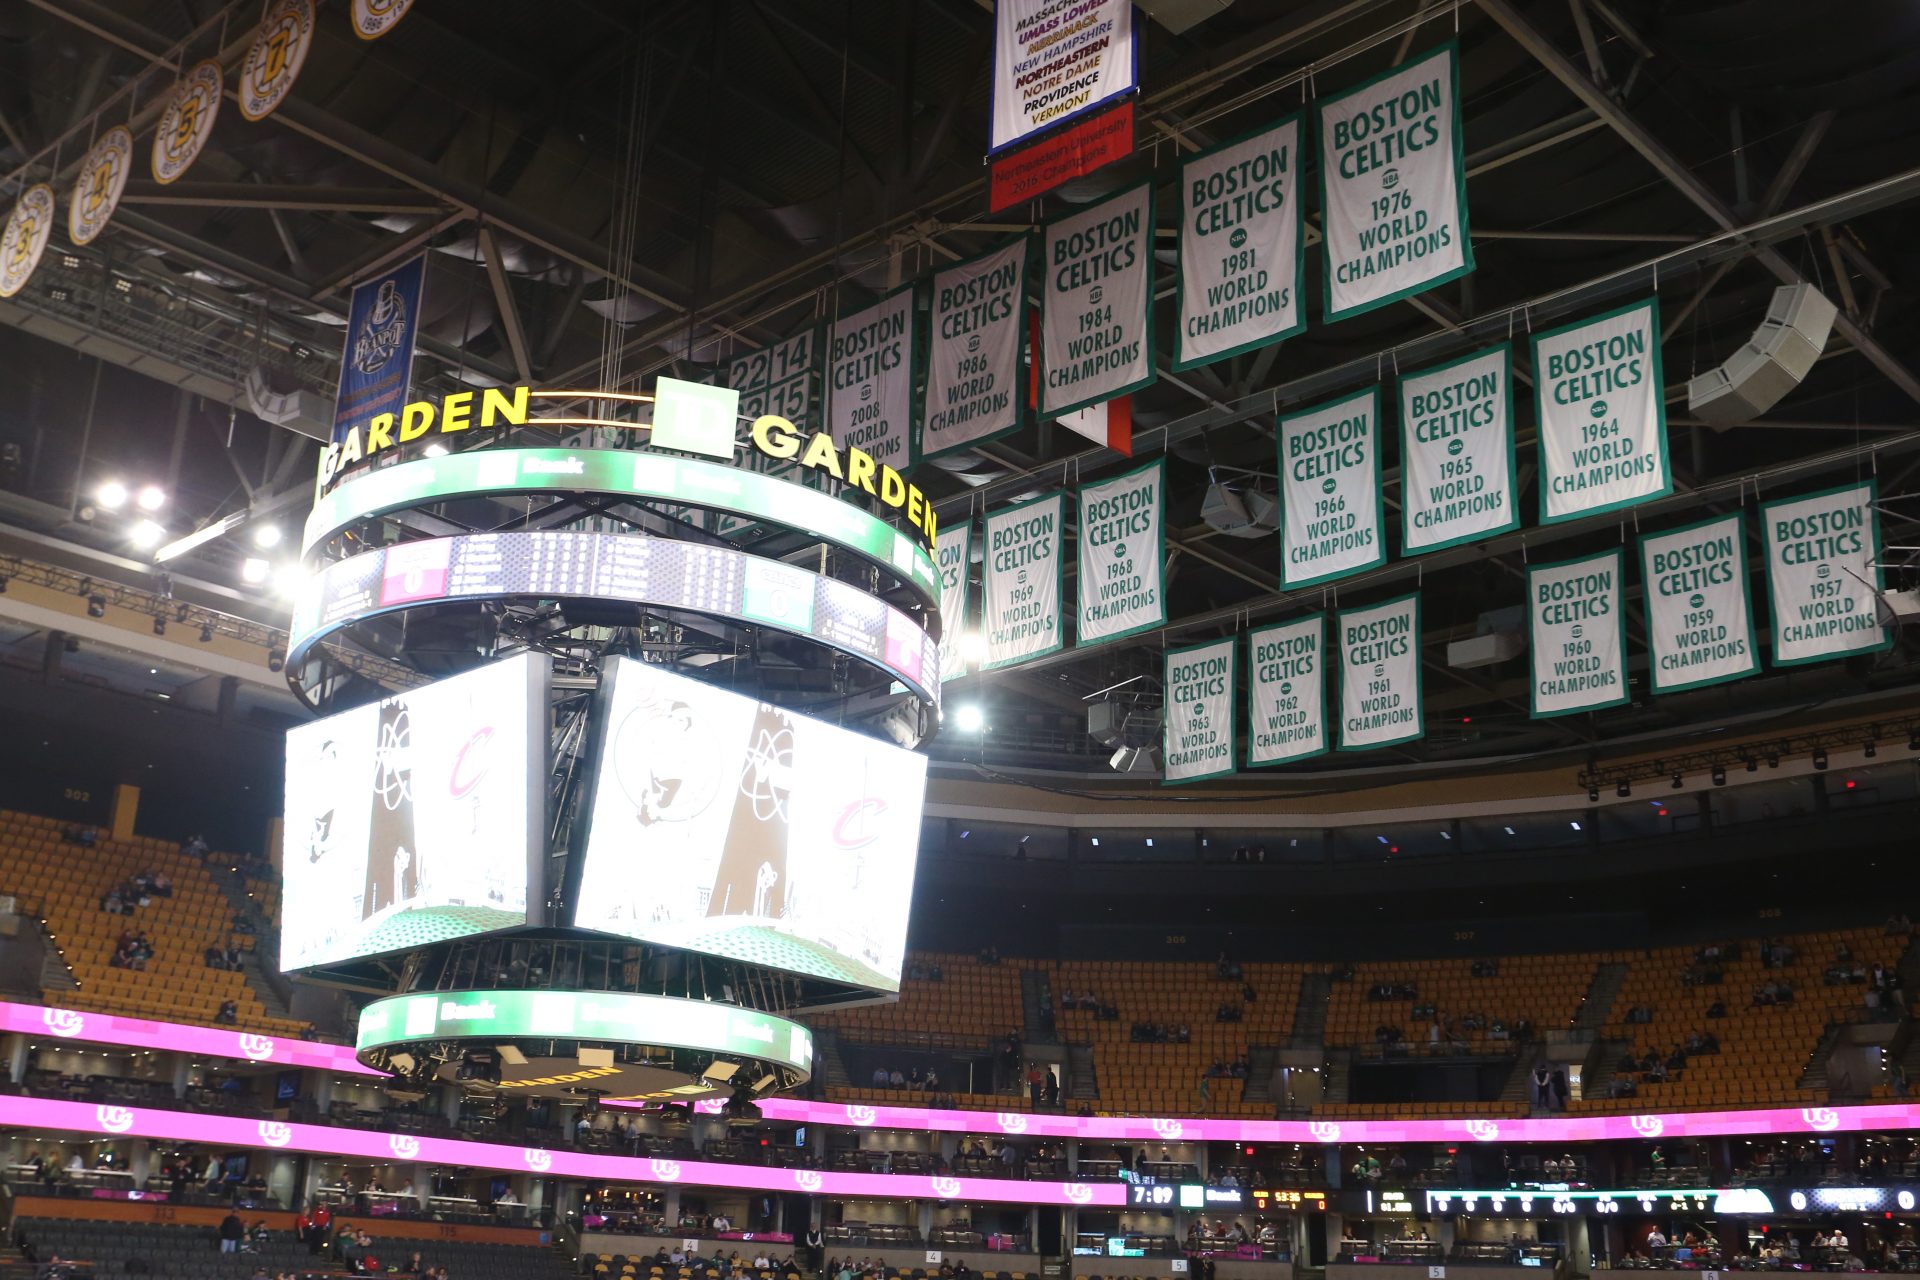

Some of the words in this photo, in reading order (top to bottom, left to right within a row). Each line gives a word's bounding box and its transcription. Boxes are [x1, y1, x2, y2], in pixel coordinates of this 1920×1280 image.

[1019, 17, 1059, 45] UMASS
[1013, 57, 1040, 76] NEW
[1044, 20, 1113, 62] HAMPSHIRE
[1016, 36, 1109, 89] NORTHEASTERN
[1023, 74, 1061, 100] NOTRE
[1066, 55, 1101, 80] DAME
[1024, 72, 1099, 114] PROVIDENCE
[1032, 90, 1091, 125] VERMONT
[1335, 79, 1440, 150] BOSTON
[995, 144, 1069, 183] Northeastern
[1071, 118, 1127, 150] University
[1043, 145, 1107, 180] Champions
[1340, 116, 1439, 179] CELTICS
[1192, 145, 1287, 208] BOSTON
[1196, 180, 1284, 236] CELTICS
[1372, 189, 1411, 221] 1976
[1054, 208, 1139, 265] BOSTON
[1360, 210, 1427, 251] WORLD
[1057, 240, 1135, 292] CELTICS
[1222, 249, 1255, 277] 1981
[1337, 225, 1450, 284] CHAMPIONS
[940, 262, 1016, 313] BOSTON
[1208, 270, 1267, 307] WORLD
[942, 292, 1011, 339] CELTICS
[1079, 305, 1111, 333] 1984
[1189, 288, 1288, 337] CHAMPIONS
[352, 320, 407, 366] BEANPOT
[834, 310, 904, 362] BOSTON
[1068, 326, 1122, 360] WORLD
[732, 353, 768, 393] 22
[777, 335, 808, 377] 14
[835, 342, 901, 390] CELTICS
[958, 354, 987, 379] 1986
[1050, 341, 1139, 388] CHAMPIONS
[1549, 329, 1644, 379] BOSTON
[948, 373, 993, 404] WORLD
[1412, 372, 1496, 418] BOSTON
[1554, 360, 1642, 405] CELTICS
[774, 378, 805, 420] 15
[851, 402, 879, 426] 2008
[930, 390, 1008, 431] CHAMPIONS
[320, 386, 530, 487] GARDEN
[845, 420, 888, 446] WORLD
[1290, 414, 1366, 458] BOSTON
[1416, 400, 1493, 443] CELTICS
[1582, 419, 1618, 443] 1964
[1294, 441, 1364, 482] CELTICS
[1440, 457, 1472, 480] 1965
[1573, 438, 1633, 468] WORLD
[752, 414, 938, 549] GARDEN
[1430, 475, 1483, 503] WORLD
[1553, 454, 1654, 494] CHAMPIONS
[1088, 484, 1153, 525] BOSTON
[1315, 495, 1345, 517] 1966
[1415, 491, 1502, 528] CHAMPIONS
[993, 513, 1053, 551] BOSTON
[1090, 510, 1150, 546] CELTICS
[1307, 513, 1355, 540] WORLD
[1776, 506, 1863, 542] BOSTON
[995, 538, 1050, 572] CELTICS
[1292, 528, 1372, 563] CHAMPIONS
[1654, 536, 1732, 574] BOSTON
[1782, 531, 1861, 565] CELTICS
[1107, 559, 1132, 579] 1968
[1659, 561, 1732, 596] CELTICS
[1011, 585, 1033, 603] 1969
[1101, 576, 1141, 600] WORLD
[1539, 571, 1610, 603] BOSTON
[1810, 580, 1842, 599] 1957
[1003, 602, 1040, 625] WORLD
[1086, 589, 1154, 622] CHAMPIONS
[1542, 595, 1609, 625] CELTICS
[1684, 609, 1713, 628] 1959
[1800, 598, 1854, 620] WORLD
[990, 615, 1052, 645] CHAMPIONS
[1348, 614, 1409, 645] BOSTON
[1676, 626, 1726, 648] WORLD
[1784, 613, 1874, 642] CHAMPIONS
[1257, 634, 1315, 663] BOSTON
[1350, 636, 1407, 665] CELTICS
[1563, 640, 1591, 657] 1960
[1661, 640, 1744, 670] CHAMPIONS
[1173, 656, 1226, 684] BOSTON
[1260, 655, 1313, 683] CELTICS
[1555, 657, 1600, 676] WORLD
[1175, 677, 1224, 703] CELTICS
[1369, 679, 1390, 695] 1961
[1540, 670, 1615, 695] CHAMPIONS
[1276, 696, 1298, 712] 1962
[1362, 694, 1400, 713] WORLD
[1189, 717, 1209, 732] 1963
[1269, 711, 1306, 729] WORLD
[1349, 708, 1413, 731] CHAMPIONS
[1182, 731, 1216, 748] WORLD
[1257, 724, 1316, 747] CHAMPIONS
[1169, 744, 1227, 766] CHAMPIONS
[63, 787, 91, 802] 302
[500, 1066, 624, 1088] GARDEN
[1259, 1200, 1265, 1209] 0
[1319, 1201, 1325, 1210] 0
[1790, 1191, 1806, 1211] 0
[1898, 1190, 1915, 1210] 0
